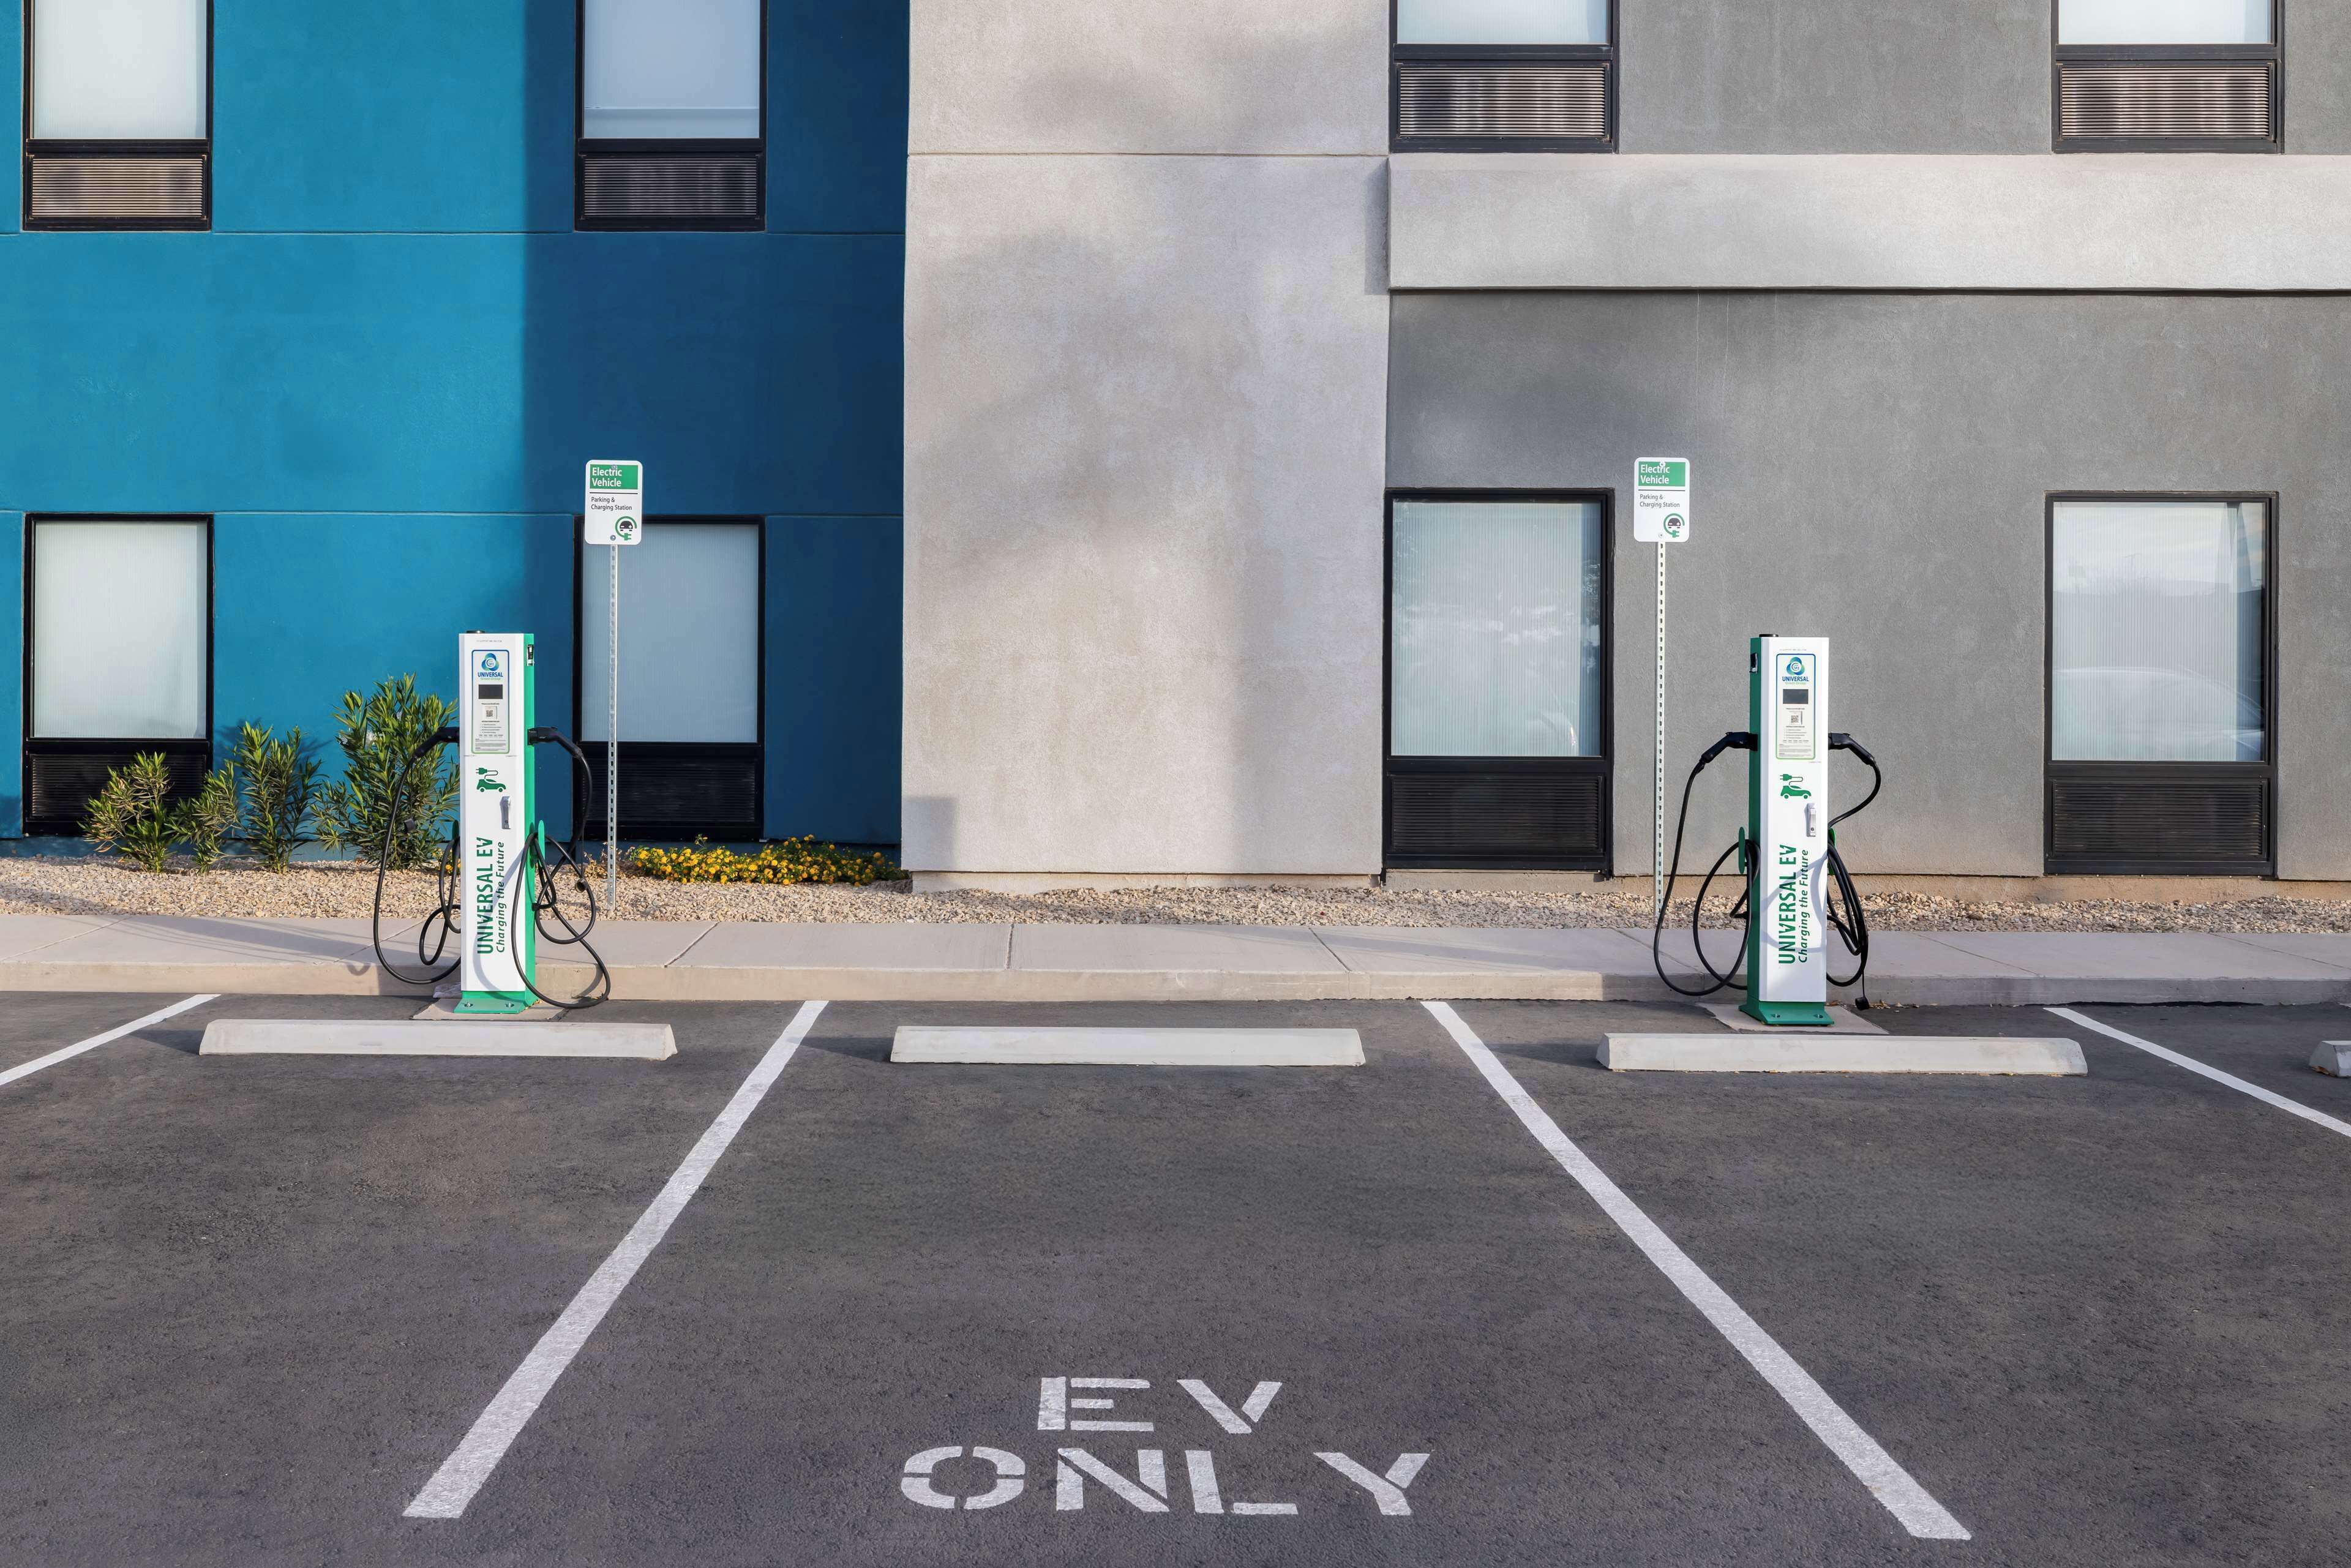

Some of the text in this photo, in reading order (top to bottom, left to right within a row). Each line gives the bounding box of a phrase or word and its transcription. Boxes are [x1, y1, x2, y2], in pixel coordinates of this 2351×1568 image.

[591, 478, 622, 487] Vehicle
[592, 467, 622, 476] Electric
[1640, 464, 1670, 473] Electric
[1640, 475, 1670, 484] Vehicle
[476, 837, 493, 954] UNIVERSAL EV
[496, 841, 507, 953] Charging the Future
[1779, 844, 1797, 964] UNIVERSAL EV
[1798, 849, 1810, 962] Charging the Future
[1037, 1376, 1283, 1435] EV
[901, 1446, 1431, 1516] ONLY
